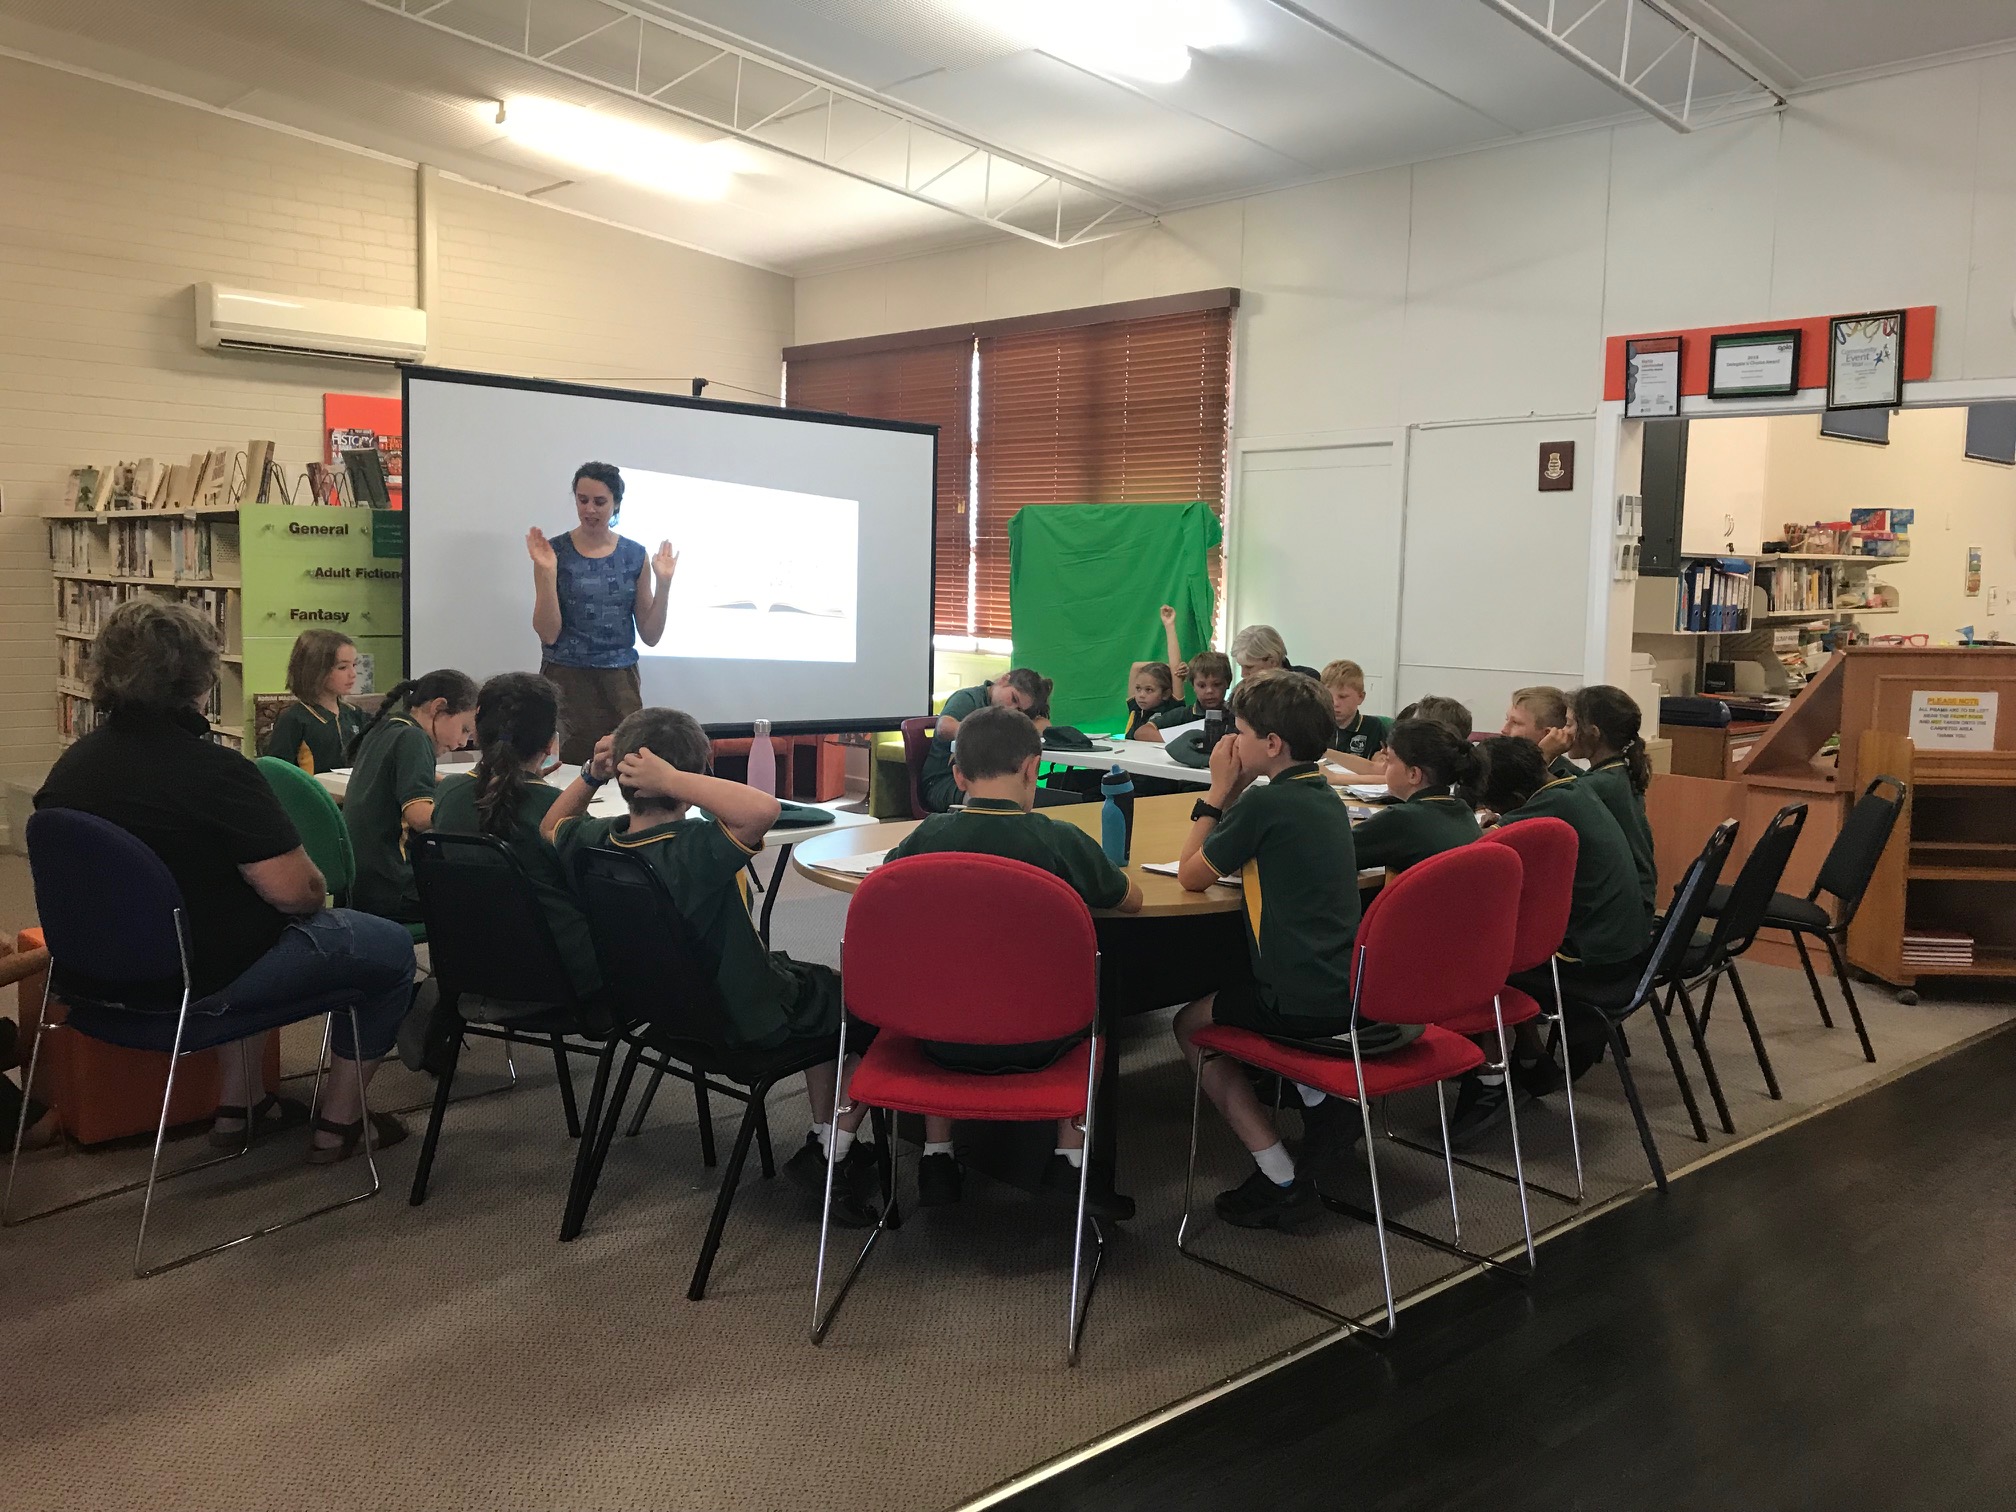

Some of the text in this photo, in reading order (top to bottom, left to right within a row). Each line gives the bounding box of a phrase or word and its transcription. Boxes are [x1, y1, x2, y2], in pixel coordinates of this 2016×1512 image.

[1846, 353, 1870, 363] Event
[289, 522, 349, 535] General
[315, 567, 400, 579] Adult Fiction
[290, 609, 350, 623] Fantasy
